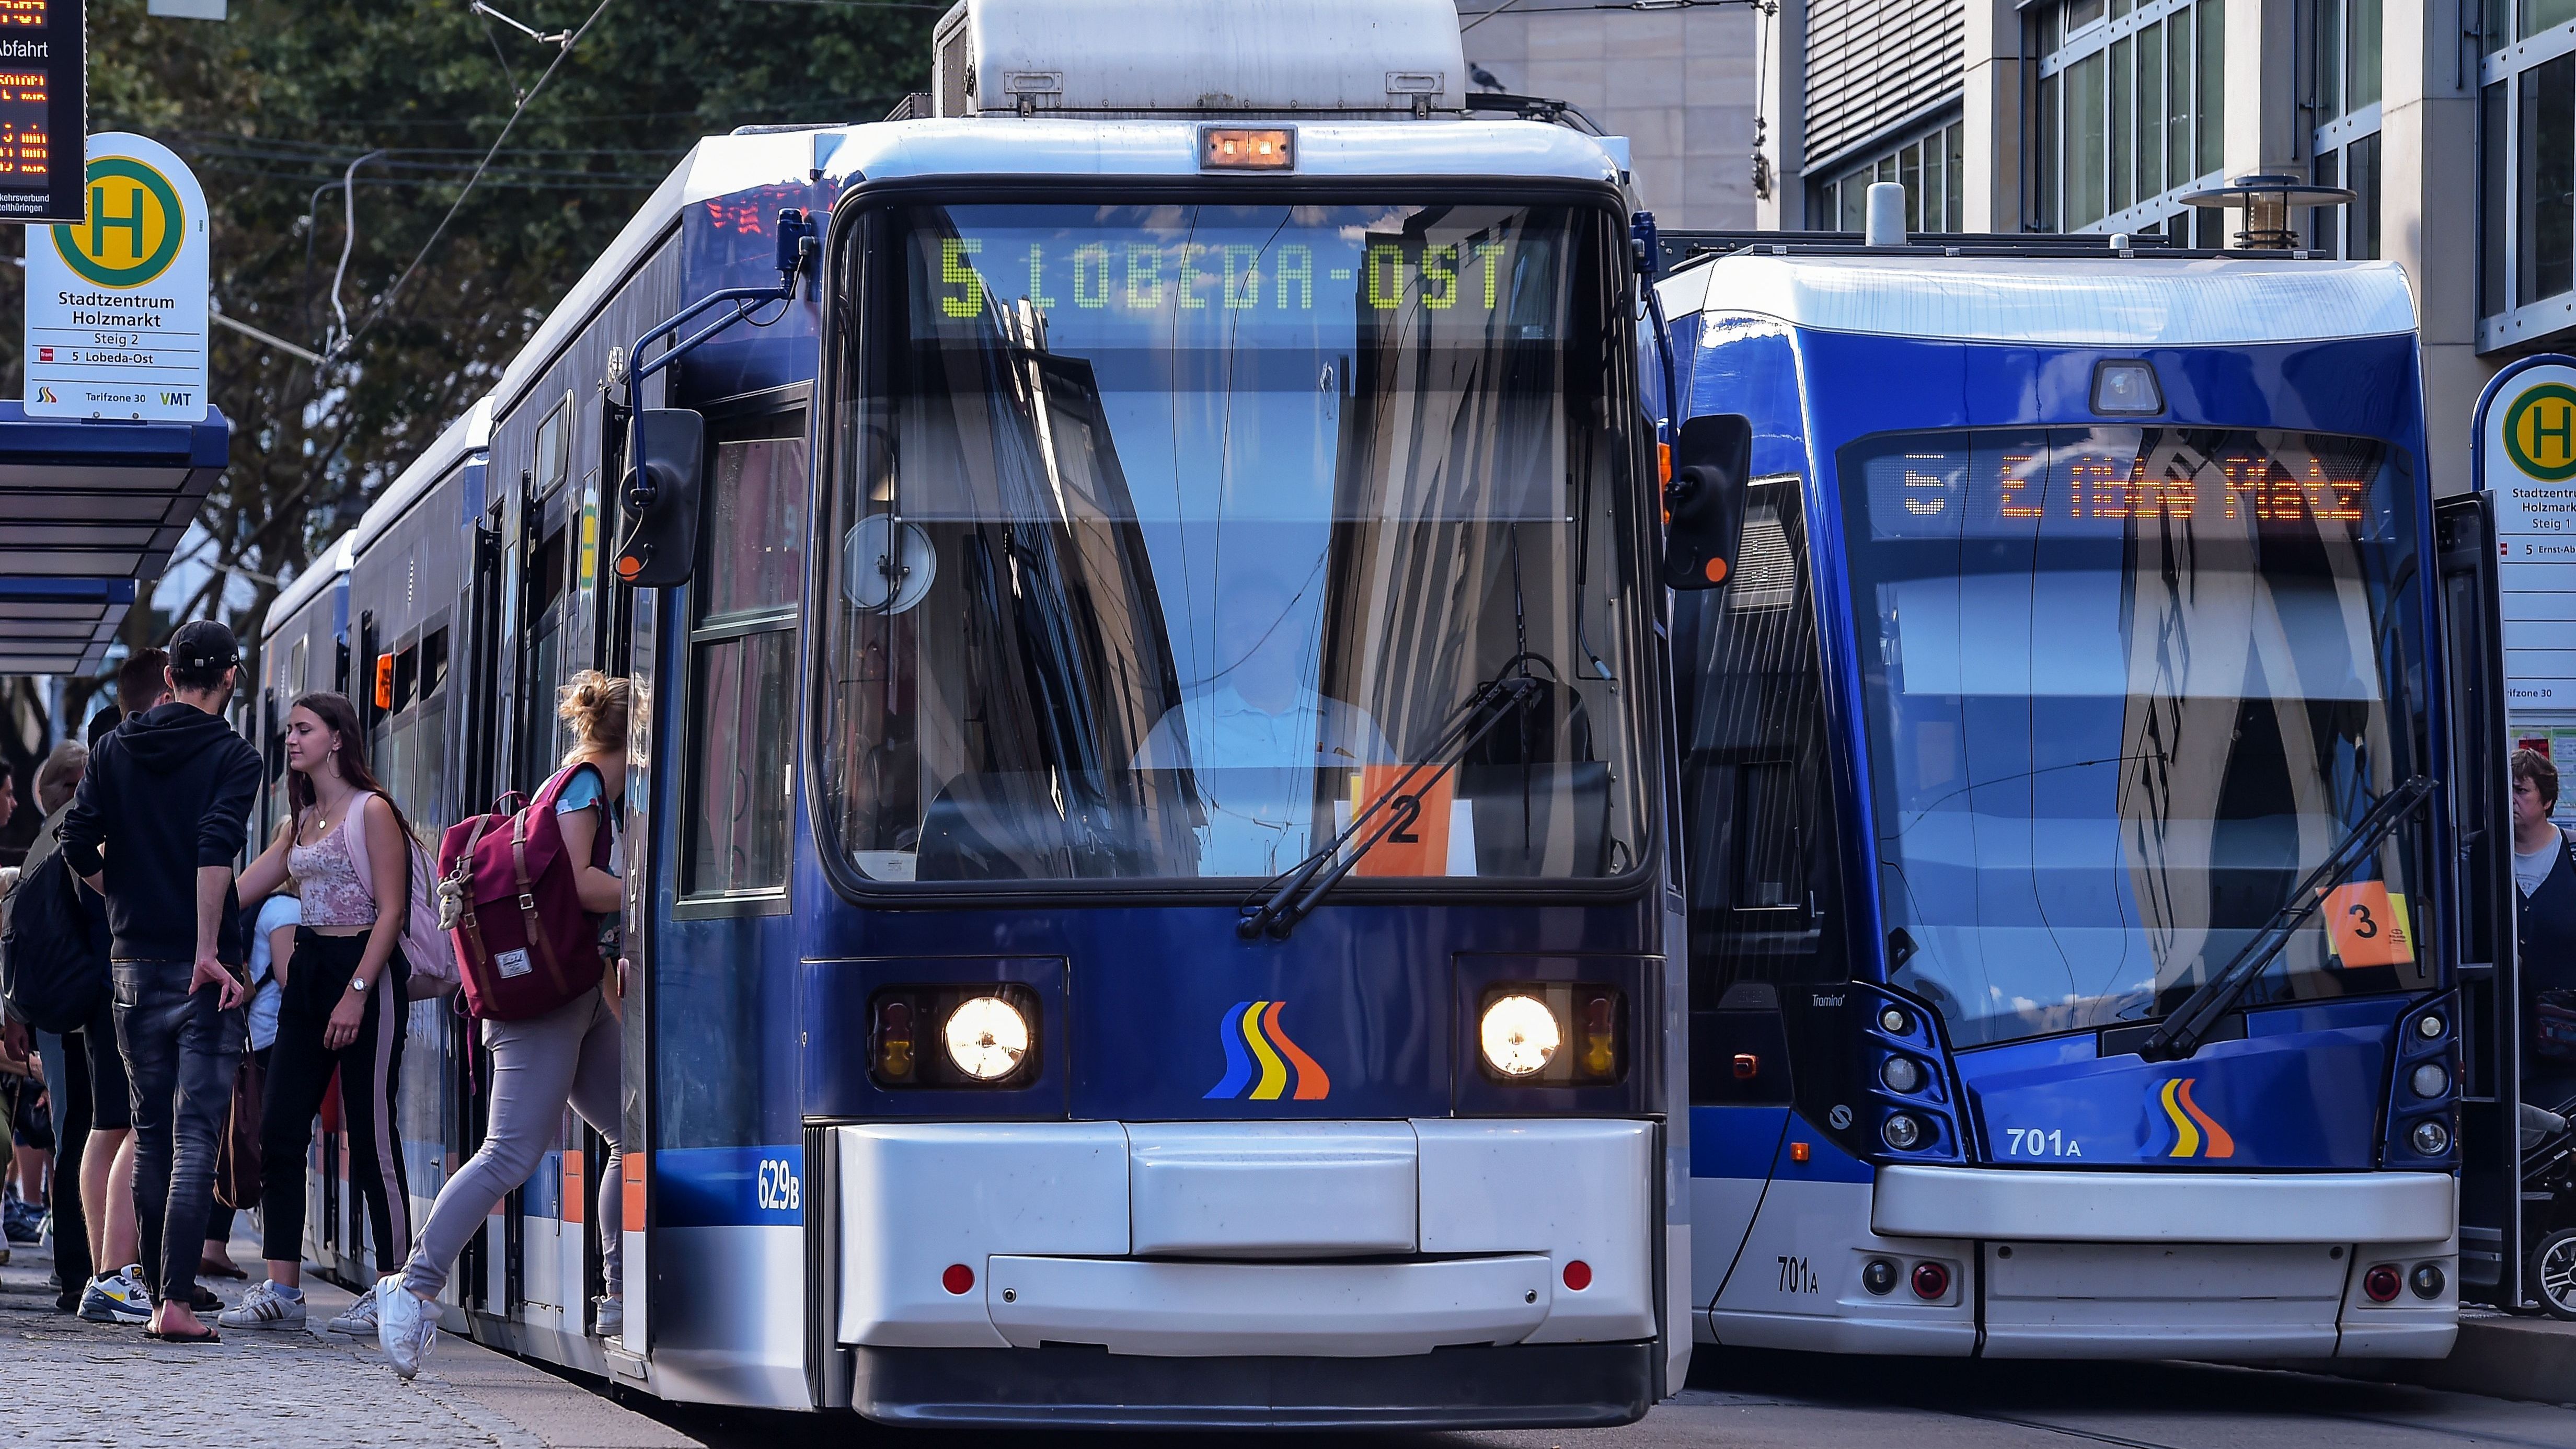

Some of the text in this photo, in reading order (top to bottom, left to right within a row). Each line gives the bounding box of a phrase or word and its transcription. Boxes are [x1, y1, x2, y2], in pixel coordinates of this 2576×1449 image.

[0, 40, 48, 58] bfahrt
[92, 187, 143, 258] H
[943, 238, 1505, 317] 5 LOBEDA-OST
[59, 291, 175, 309] Stadtzentrum
[73, 311, 161, 327] Holzmarkt
[95, 334, 138, 347] Steig 2
[72, 352, 79, 361] 5
[86, 352, 153, 364] Lobeda-Ost
[86, 393, 146, 402] Tarifzone 30
[160, 393, 191, 406] VMT
[2533, 406, 2571, 458] H
[2533, 519, 2570, 531] Steig 1
[2526, 544, 2533, 555] 5
[1387, 795, 1421, 843] 2
[2349, 904, 2377, 938] 3
[1812, 994, 1843, 1007] Tramino
[2007, 1129, 2082, 1157] 701A
[758, 1159, 800, 1210] 629B
[1777, 1256, 1819, 1294] 701A
